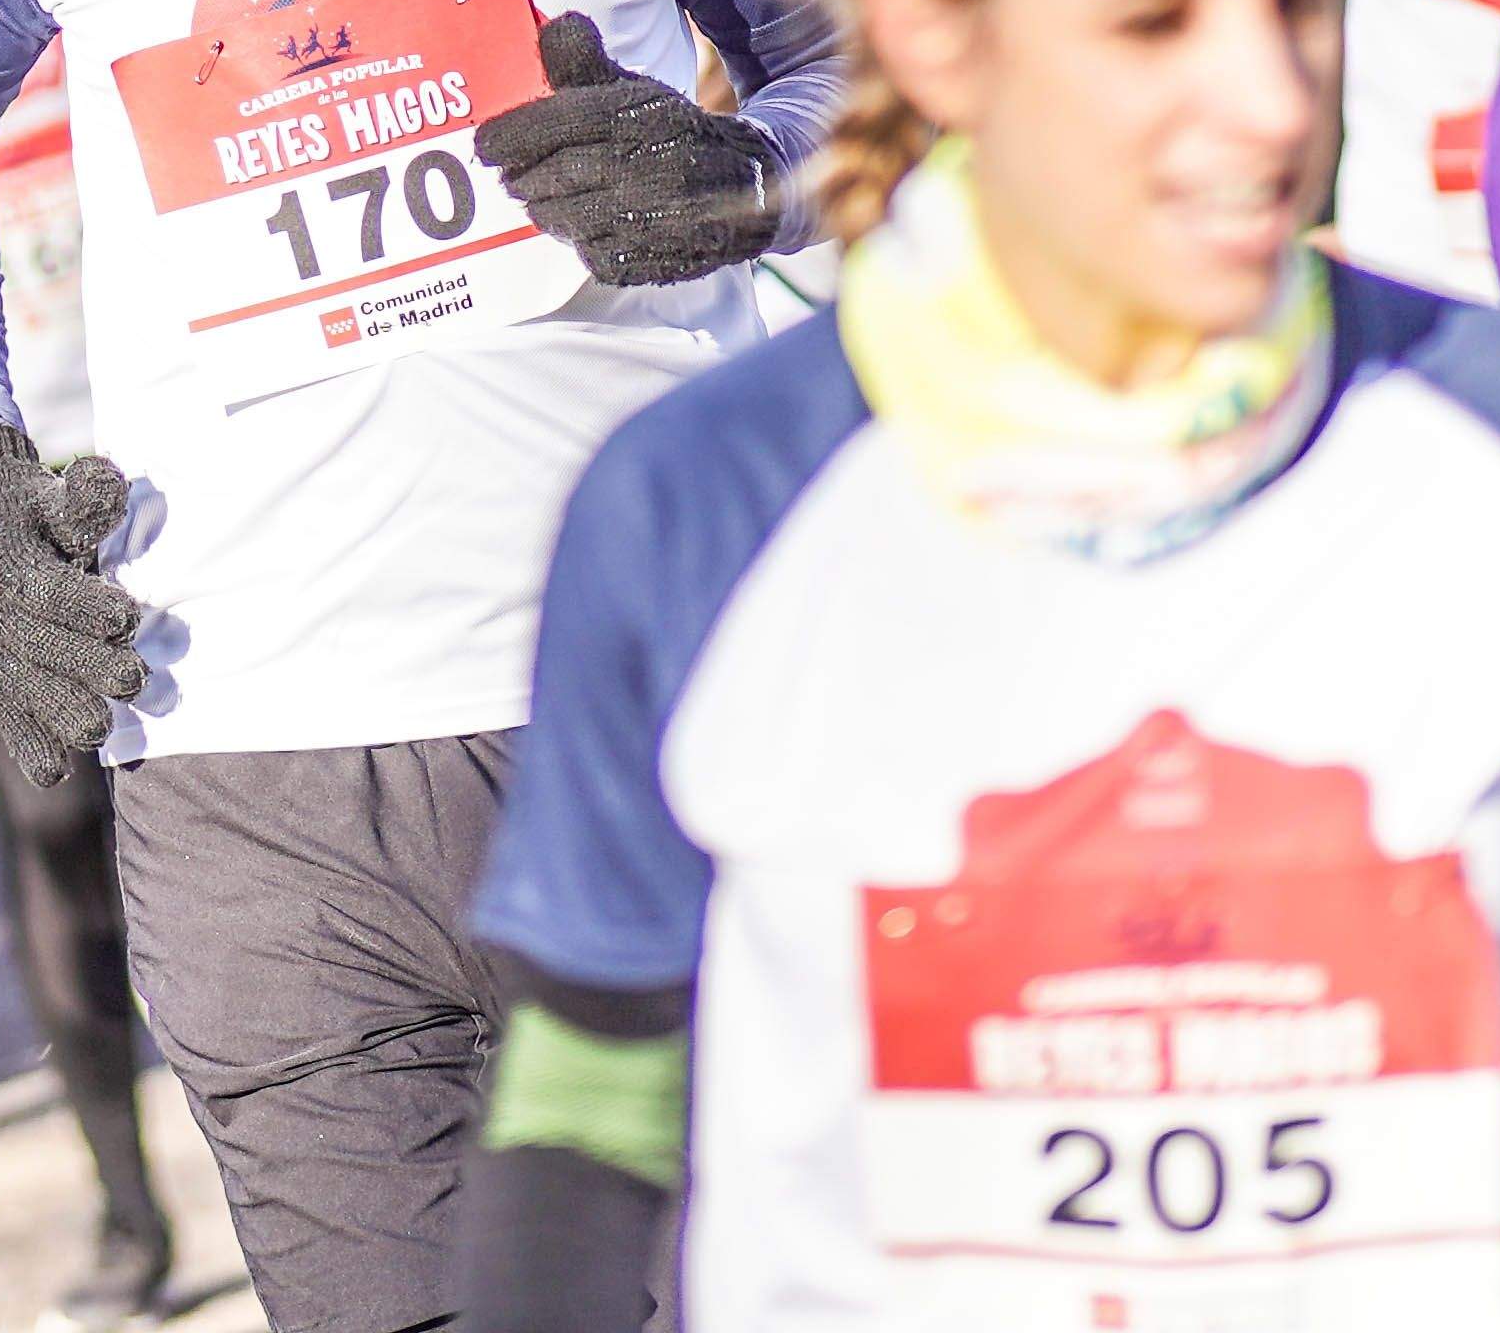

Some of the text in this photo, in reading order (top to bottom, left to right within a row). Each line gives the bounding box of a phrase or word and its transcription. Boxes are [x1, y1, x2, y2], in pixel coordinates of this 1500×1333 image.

[213, 71, 472, 185] REYES MAGOS
[238, 54, 424, 117] CARRERA POPULAR
[265, 149, 477, 280] 170
[360, 273, 468, 315] Comunidad
[367, 293, 473, 337] de Madrid
[1041, 1115, 1335, 1234] 205
